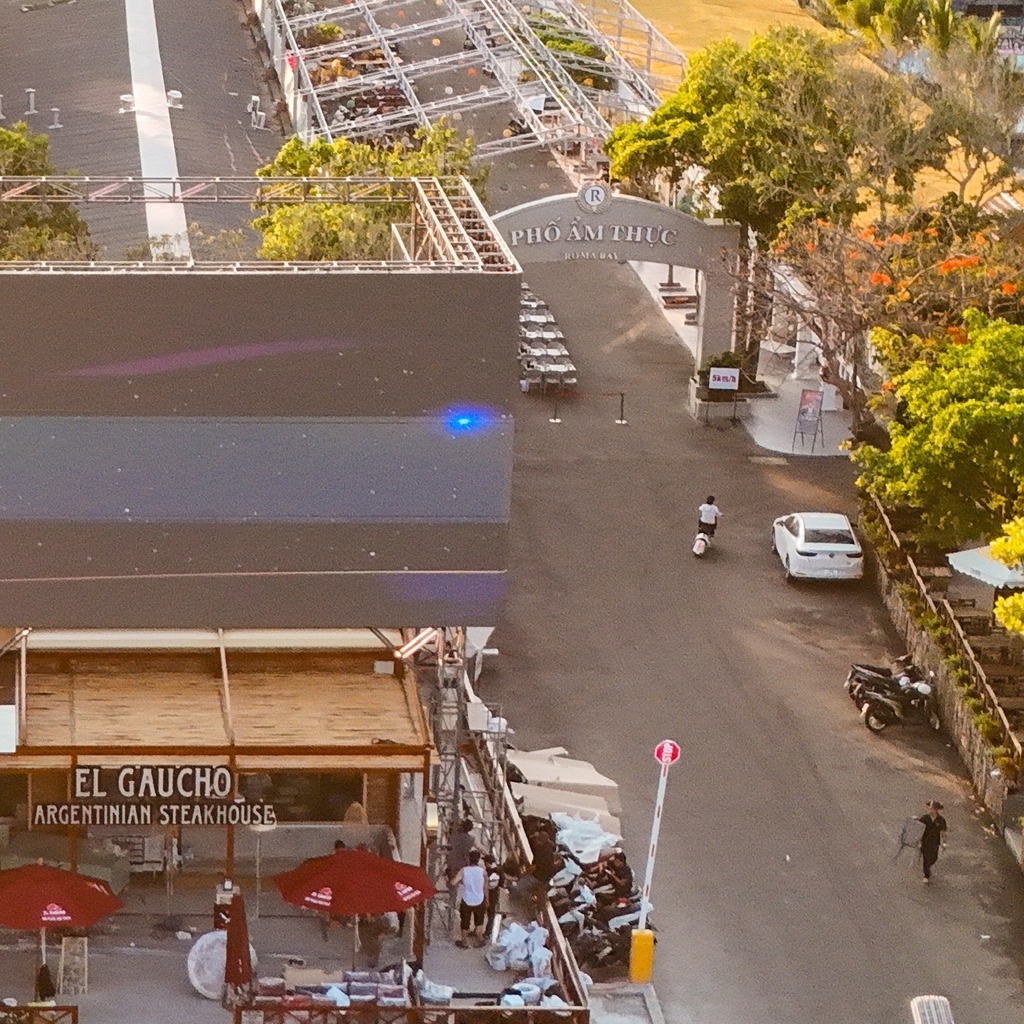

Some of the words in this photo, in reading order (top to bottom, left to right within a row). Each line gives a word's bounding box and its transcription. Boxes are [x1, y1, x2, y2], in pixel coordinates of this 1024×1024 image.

[590, 189, 601, 202] R
[511, 217, 561, 246] PHỐ
[567, 216, 604, 242] ẨM
[610, 225, 677, 248] THỰC
[564, 251, 596, 260] ROMA
[75, 768, 107, 798] EL
[118, 767, 232, 798] GAUCHO
[34, 804, 151, 825] ARGENTINIAN
[160, 804, 275, 825] STEAKHOUSE
